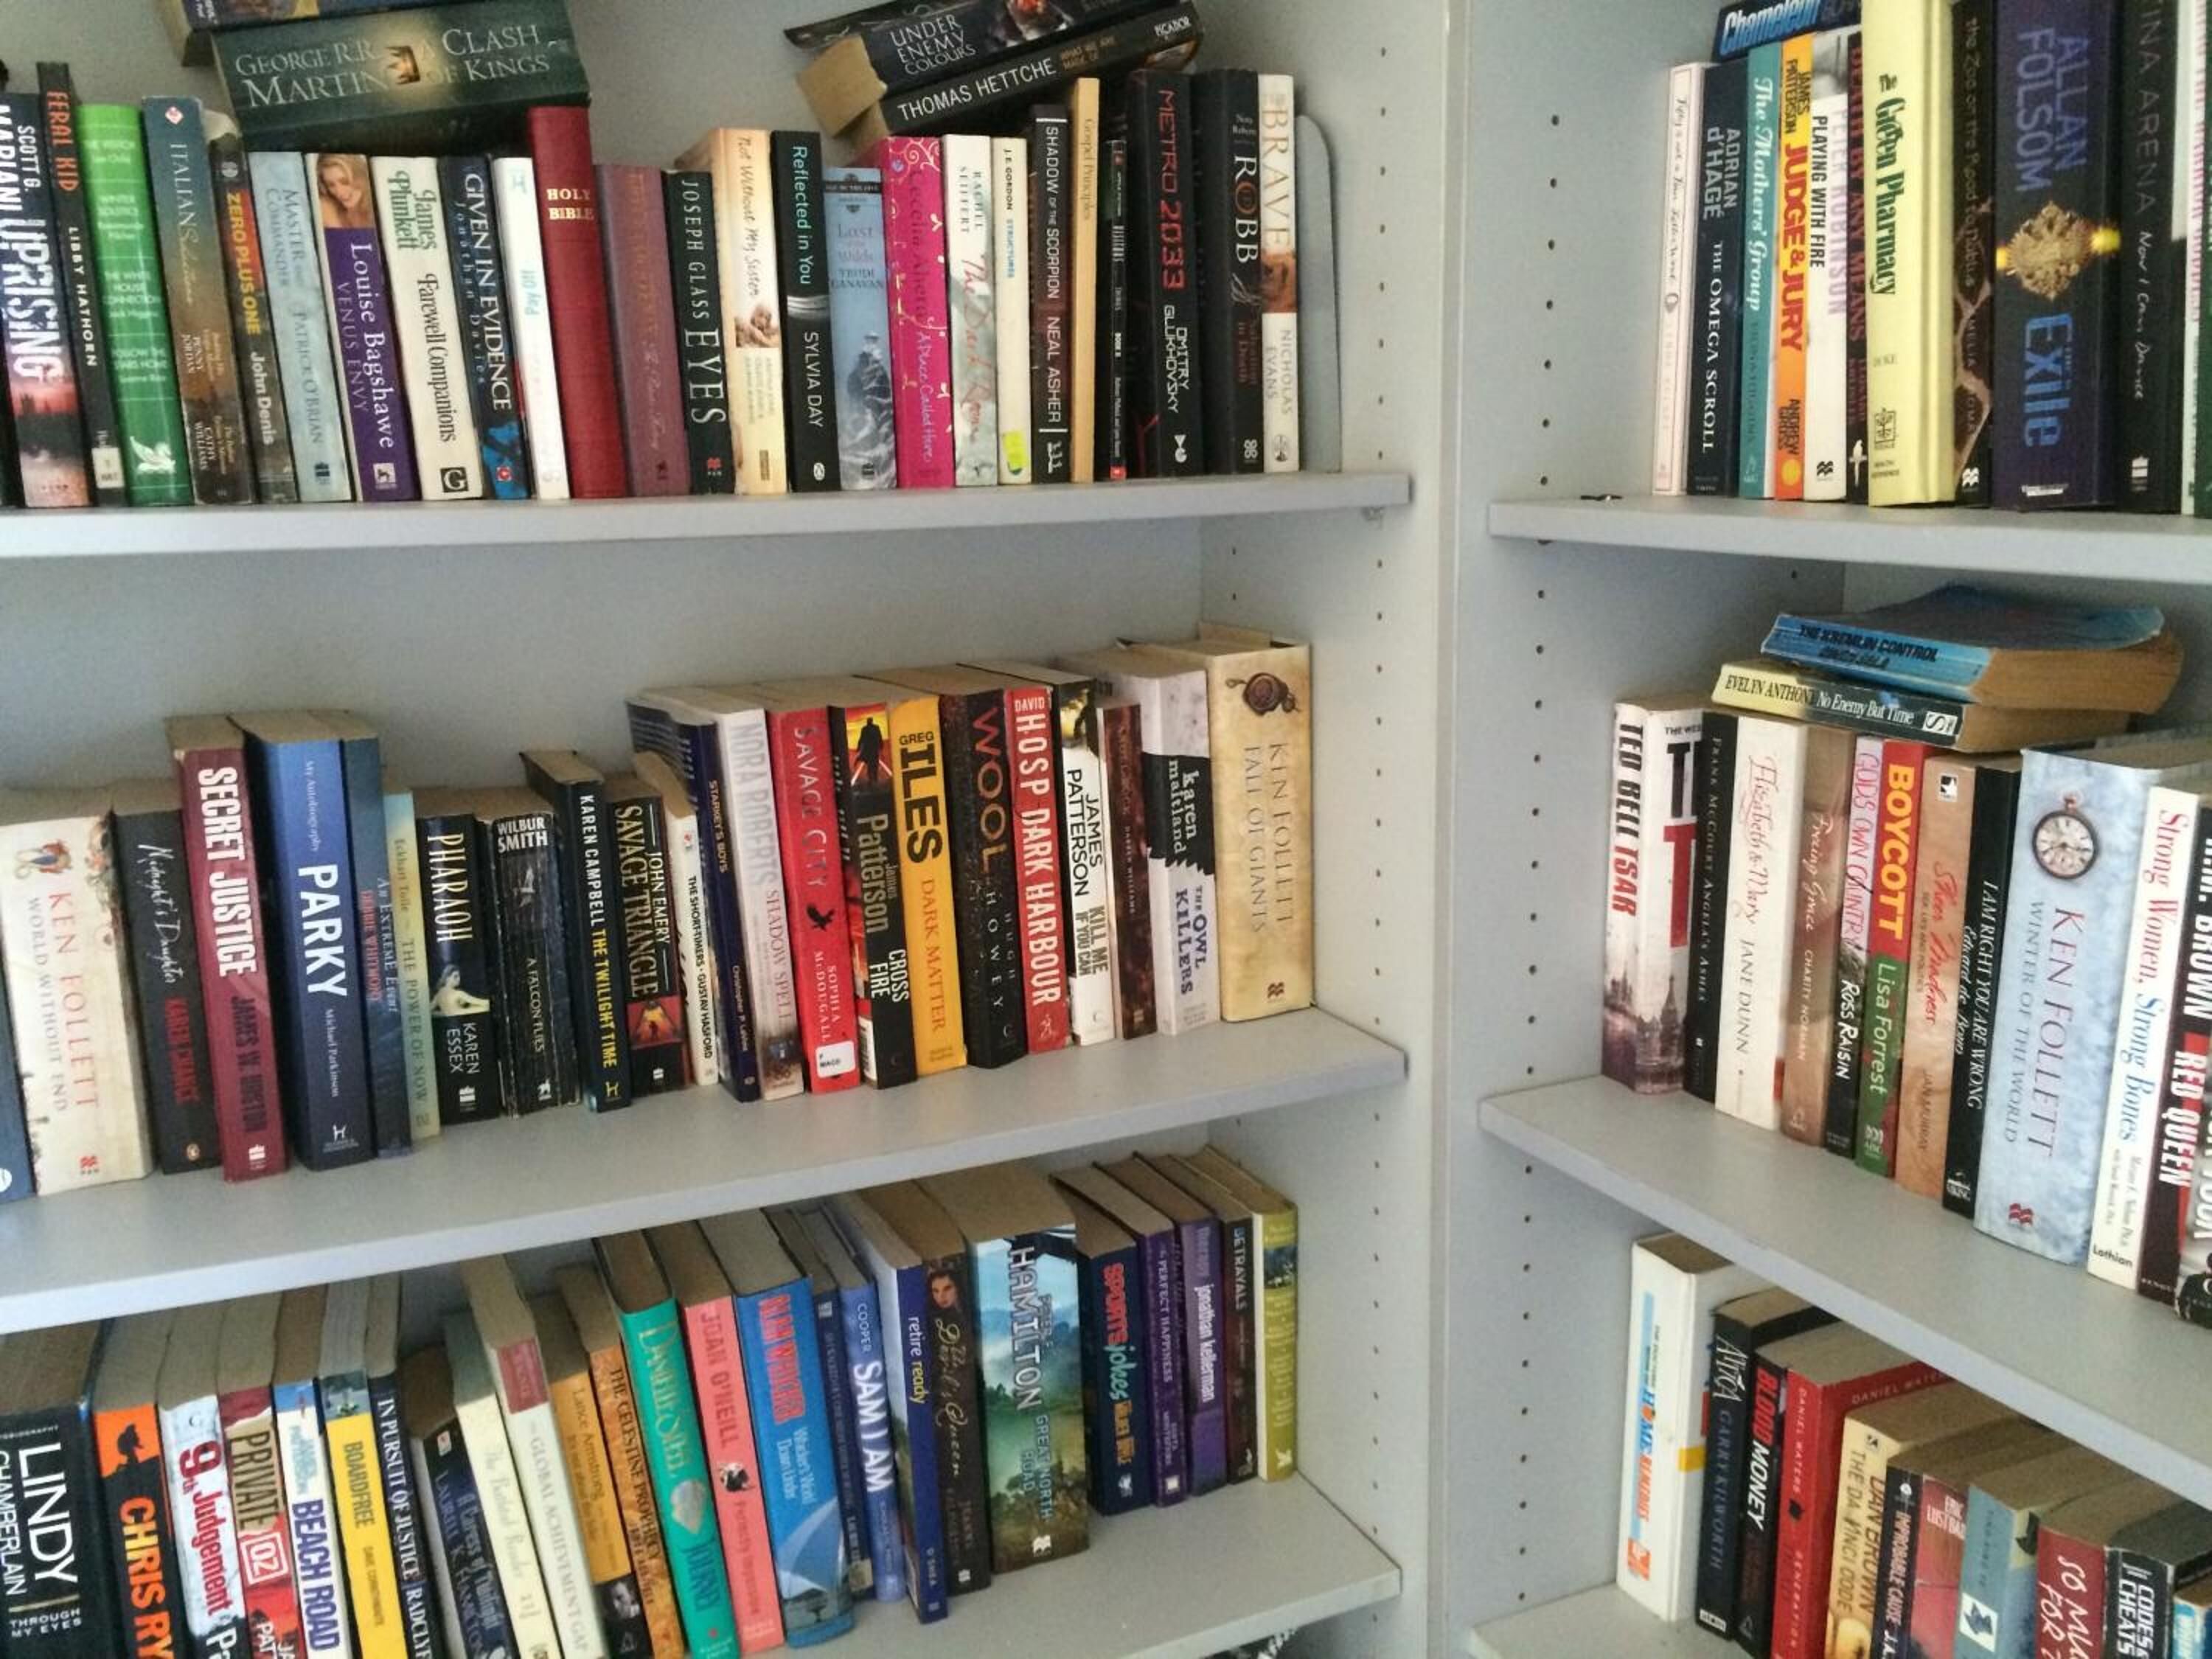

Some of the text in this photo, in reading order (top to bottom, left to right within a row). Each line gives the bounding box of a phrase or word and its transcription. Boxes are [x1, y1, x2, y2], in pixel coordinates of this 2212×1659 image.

[890, 15, 959, 47] UNDER
[898, 30, 967, 63] ENEMY
[904, 44, 977, 76] COLOURS
[46, 90, 79, 192] FERAL KID
[243, 69, 389, 108] MARTIN
[897, 58, 1057, 122] THOMAS HETTCHE
[2014, 24, 2056, 192] FOLSOM
[2053, 36, 2089, 171] ALLAN
[388, 172, 415, 251] Plunkett
[546, 189, 590, 201] HOLY
[549, 207, 594, 220] BIBLE
[793, 147, 813, 284] Reflected in You
[1080, 119, 1095, 220] Gospel Principles
[1158, 90, 1183, 289] METRO 2033
[1263, 110, 1289, 248] BRAVE
[1723, 129, 1740, 208] ADRIAN
[1745, 77, 1773, 311] The Mothers' Group
[1809, 116, 1828, 268] PLAYING WITH FIRE
[1870, 97, 1906, 295] Green Pharmacy
[1, 220, 66, 383] UPRISING
[68, 226, 97, 367] LIBBY HATHORN
[226, 193, 260, 335] ZERO PLUS ONE
[464, 174, 511, 409] GIVEN IN EVIDENCE
[1781, 143, 1806, 352] JUDGE & JURY
[336, 282, 368, 411] VENUS ENVY
[349, 244, 394, 448] Louise Bagshawe
[683, 180, 726, 424] JOSEPH GLASS EYES
[1702, 241, 1723, 453] THE OMEGA SCROLL
[248, 351, 275, 445] John Denis
[417, 274, 459, 442] Farewell Companions
[805, 332, 823, 428] SYLVIA DAY
[1048, 317, 1060, 422] NEAL ASHER
[1164, 306, 1178, 413] GLUKHOVSKY
[1178, 328, 1189, 390] DMITRY
[1266, 347, 1277, 400] EVANS
[1281, 330, 1292, 414] NICHOLAS
[1788, 400, 1801, 456] ANDREW
[729, 722, 765, 790] NORA
[902, 745, 941, 863] ILES
[973, 708, 1006, 874] WOOL
[1183, 772, 1199, 838] karen
[198, 768, 257, 977] SECRET JUSTICE
[498, 816, 546, 830] WILBUR
[498, 830, 548, 852] SMITH
[737, 796, 779, 885] ROBERTS
[857, 815, 891, 933] Patterson
[1018, 714, 1061, 1004] HOSP DARK HARBOUR
[1068, 769, 1088, 896] PATTERSON
[1086, 793, 1102, 866] JAMES
[1612, 724, 1644, 917] TED BELL TSAR
[298, 864, 347, 996] PARKY
[427, 833, 473, 942] PHARAOH
[580, 795, 617, 1068] KAREN CAMPBELL THE TWILIGHT TIME
[615, 805, 657, 997] SAVAGE TRIANGLE
[645, 852, 669, 944] JOHN EMERY
[1090, 906, 1107, 973] KILL ME
[1870, 765, 1914, 1093] BOYCOTT Lisa Forrest
[827, 966, 841, 1022] SOPHIA
[869, 963, 890, 998] FIRE
[889, 950, 908, 1002] CROSS
[922, 879, 946, 1032] DARK MATTER
[986, 893, 1005, 1008] HOWEY
[1177, 890, 1194, 995] KILLERS
[1736, 938, 1757, 1054] JANE DUNN
[49, 891, 98, 1110] KEN FOLLETT
[448, 1028, 463, 1073] ESSEX
[463, 1023, 479, 1074] KAREN
[698, 974, 713, 1059] GUSTAV HASFORD
[1834, 981, 1860, 1079] ROSS RAISIN
[2027, 908, 2085, 1157] KEN FOLLETT
[1916, 1069, 1934, 1153] JAN MURRAY
[2160, 1051, 2205, 1187] RED QUEEN
[858, 1303, 870, 1352] COOPER
[908, 1317, 928, 1404] retire ready
[1009, 1247, 1043, 1411] HAMILTON
[1158, 1260, 1173, 1382] PERFECT HAPPINESS
[702, 1313, 736, 1450] JOAN O'NEILL
[853, 1360, 887, 1425] SAM
[344, 1441, 375, 1528] BOARDFREE
[609, 1368, 658, 1560] THE CELESTINE PROPHECY
[864, 1447, 894, 1492] AM
[1035, 1415, 1052, 1518] GREAT NORTH
[1747, 1368, 1778, 1530] BLOOD MONEY
[1792, 1386, 1806, 1494] DANIEL WATERS
[18, 1443, 77, 1583] LINDY
[119, 1498, 166, 1610] CHRIS
[292, 1499, 340, 1651] BEACH ROAD
[2117, 1579, 2137, 1656] CHEATS
[2137, 1585, 2154, 1651] CODES
